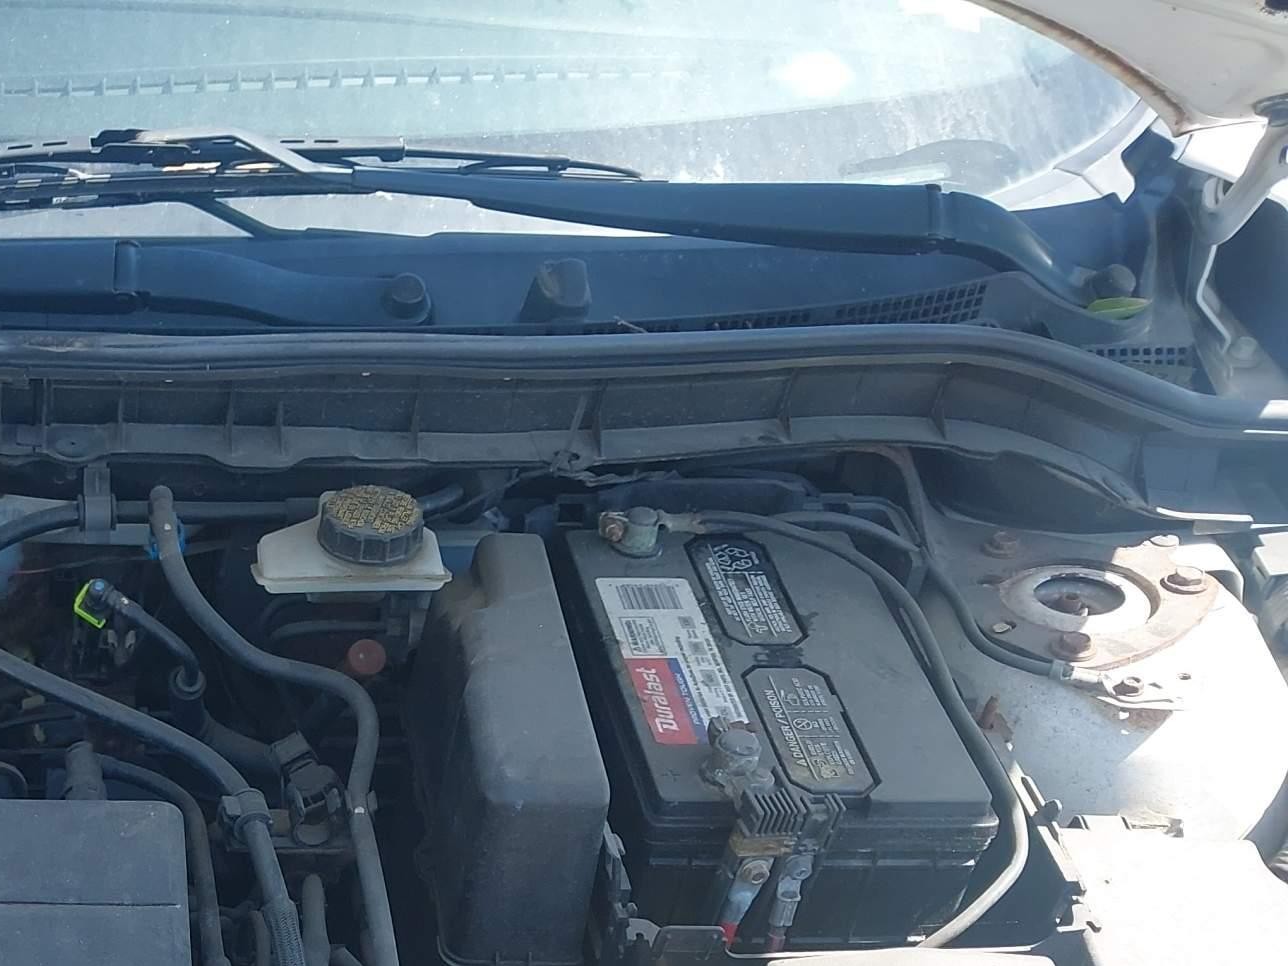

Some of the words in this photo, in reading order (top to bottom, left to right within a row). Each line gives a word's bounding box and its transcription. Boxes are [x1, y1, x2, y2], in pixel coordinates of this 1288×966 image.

[635, 667, 680, 733] Duralast
[763, 690, 785, 719] POISON
[780, 725, 806, 759] DANGER
